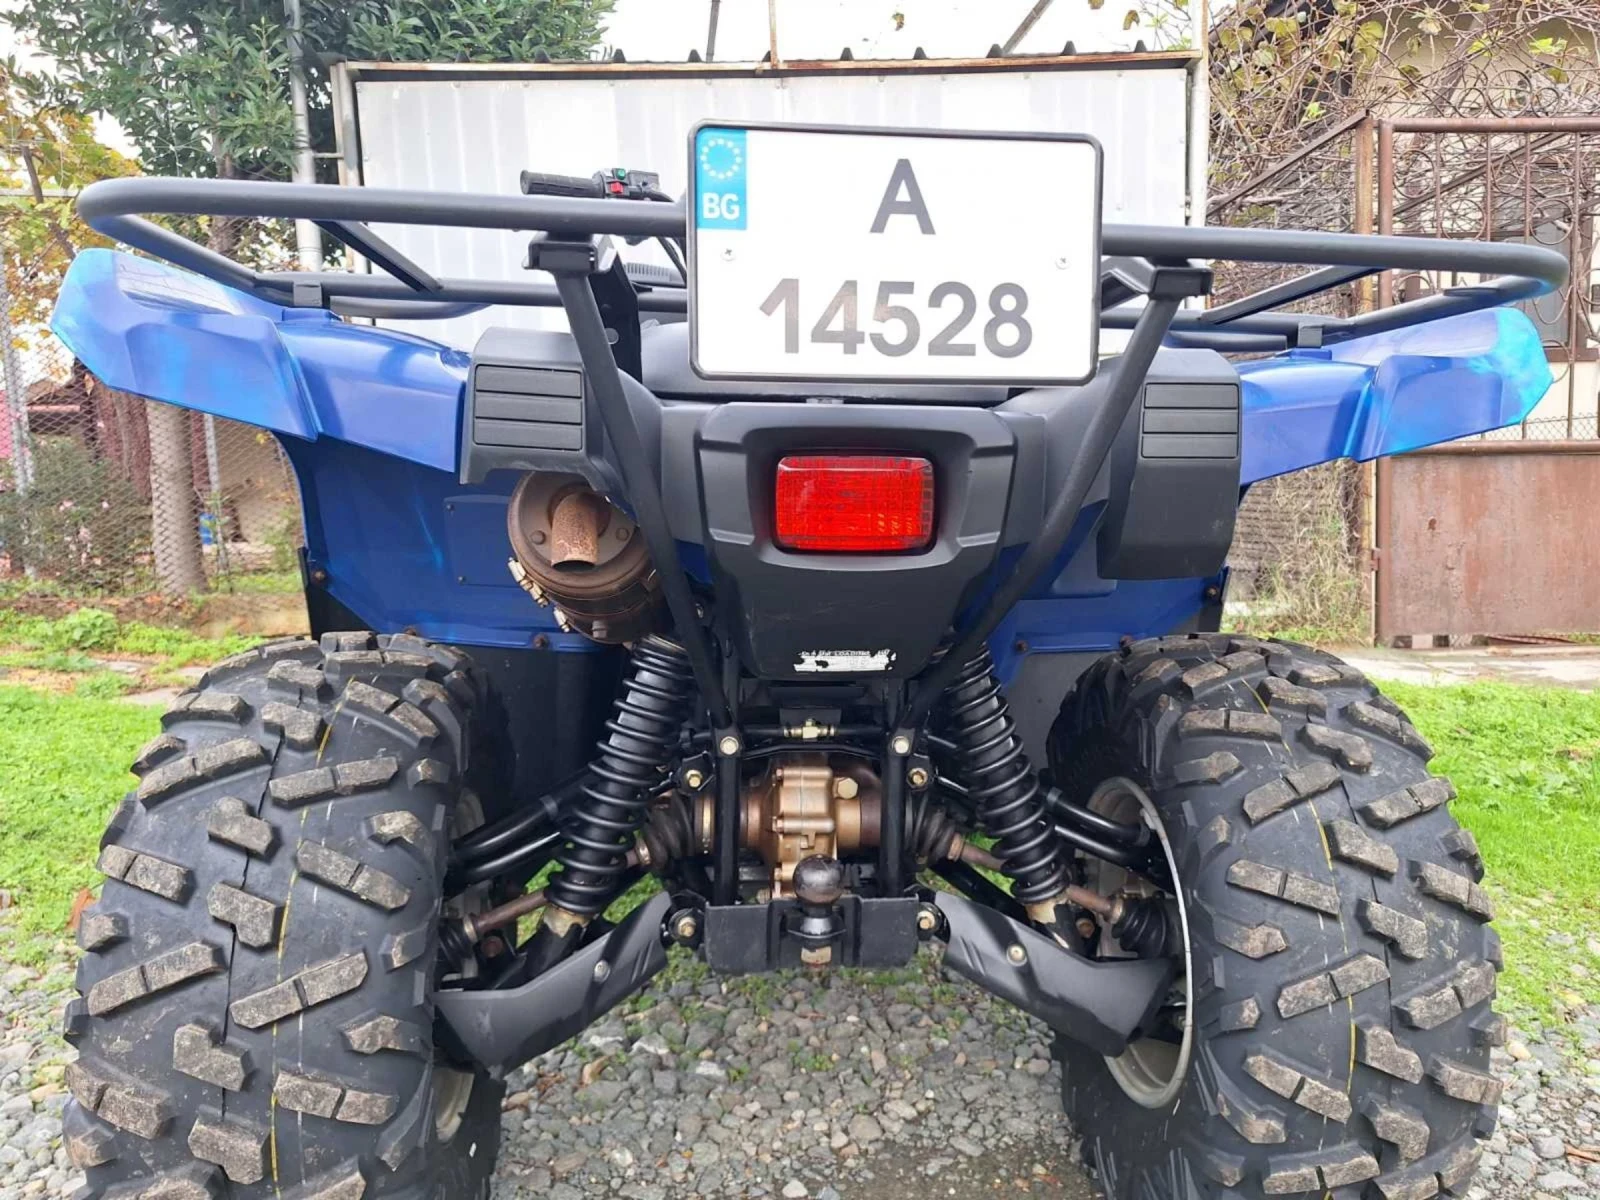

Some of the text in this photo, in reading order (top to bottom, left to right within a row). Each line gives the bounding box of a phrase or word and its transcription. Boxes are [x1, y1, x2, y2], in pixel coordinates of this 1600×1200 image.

[703, 193, 740, 220] BG
[870, 158, 936, 235] A
[759, 278, 1033, 358] 14528
